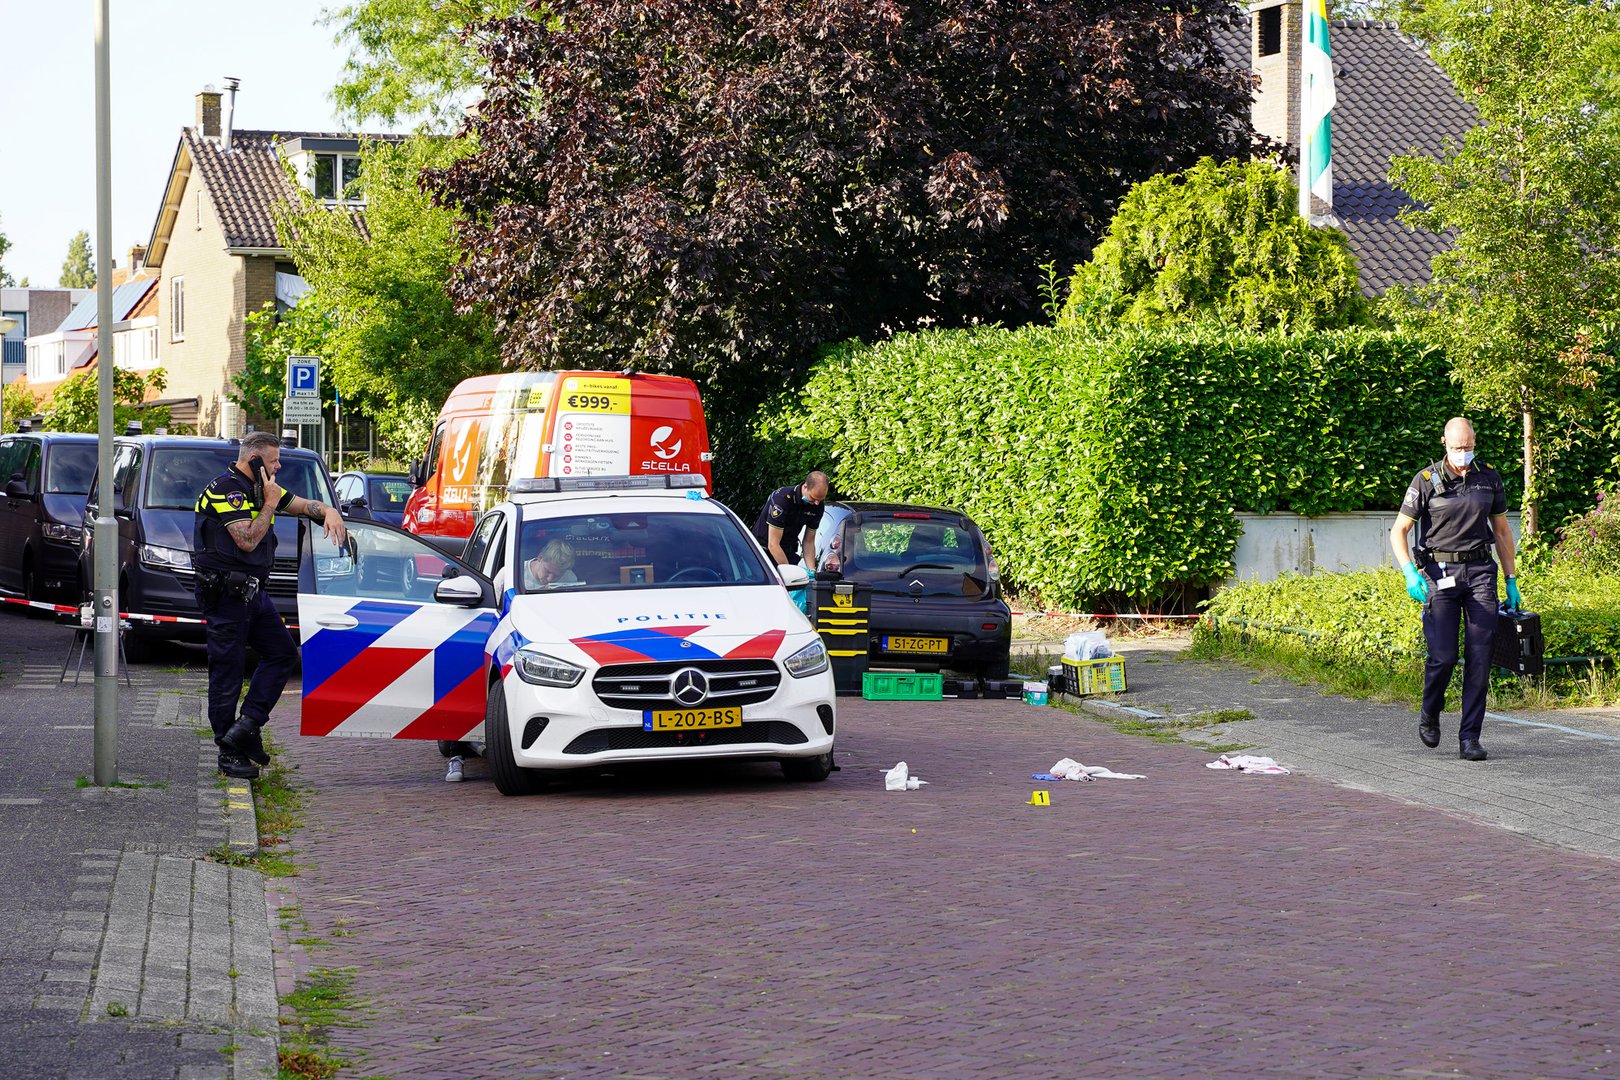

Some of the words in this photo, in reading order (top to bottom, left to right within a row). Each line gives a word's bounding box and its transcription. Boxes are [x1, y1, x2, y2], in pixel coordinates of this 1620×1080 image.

[297, 368, 310, 387] P
[567, 395, 618, 411] €999,-
[617, 613, 727, 623] POLITIE
[894, 638, 943, 650] 51-ZG-PT
[658, 710, 734, 728] L-202-BS
[1038, 792, 1044, 803] 1
